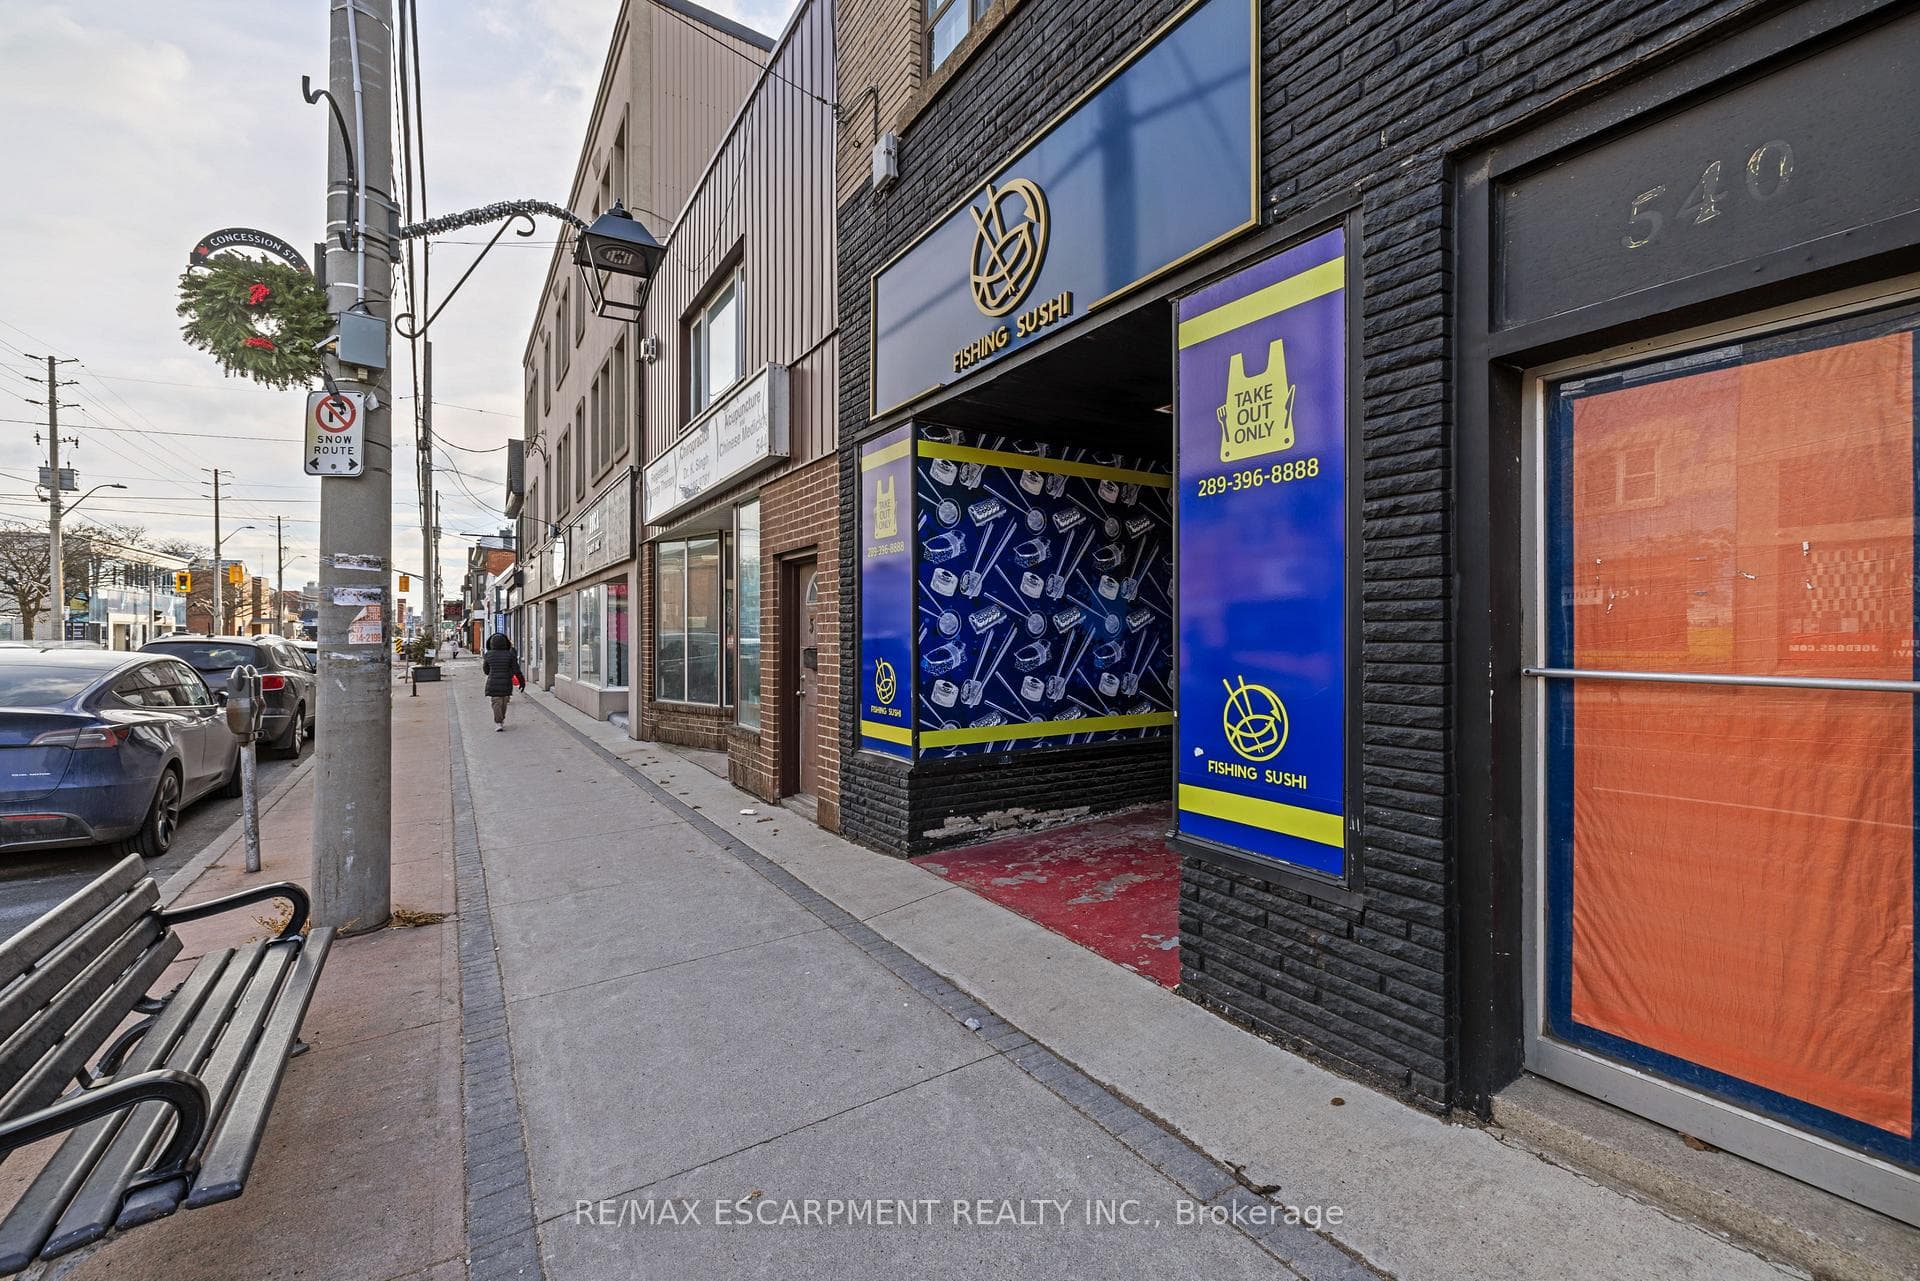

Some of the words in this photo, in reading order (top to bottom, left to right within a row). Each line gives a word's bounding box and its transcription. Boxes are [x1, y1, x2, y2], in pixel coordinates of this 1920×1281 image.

[1621, 139, 1794, 249] 540
[210, 233, 281, 251] CONCESSION
[283, 249, 297, 263] ST.
[953, 325, 1009, 373] FISHING
[1016, 290, 1073, 338] SUSHI
[1234, 383, 1273, 408] TAKE
[725, 391, 761, 428] Acupuncture
[1237, 402, 1272, 426] OUT
[317, 435, 352, 444] SNOW
[1234, 420, 1274, 444] ONLY
[314, 446, 355, 455] ROUTE
[720, 433, 741, 457] Chinese
[1198, 457, 1319, 497] 289-396-8888
[880, 508, 891, 520] OUT
[871, 705, 887, 715] FISHING
[888, 708, 902, 718] SUSHI
[1208, 759, 1258, 780] FISHING
[1265, 769, 1307, 790] SUSHI
